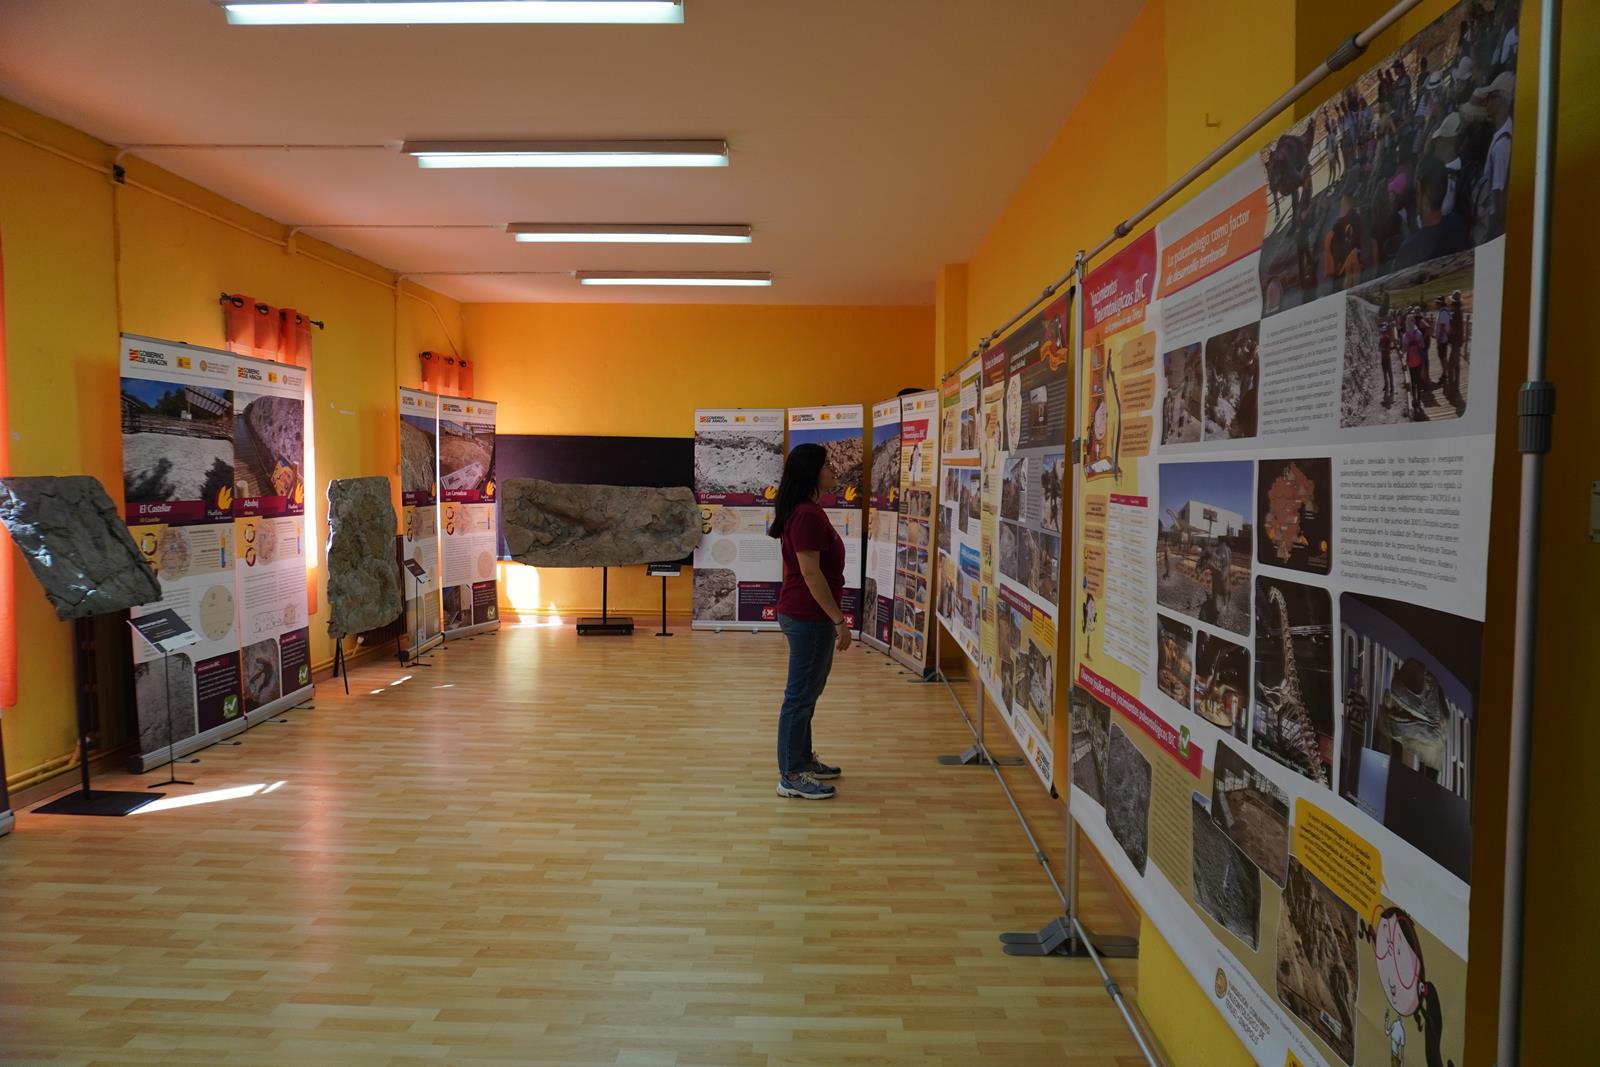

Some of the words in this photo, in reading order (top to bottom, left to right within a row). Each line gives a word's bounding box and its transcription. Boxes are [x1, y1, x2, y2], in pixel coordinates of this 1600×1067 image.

[1211, 224, 1228, 242] como
[1228, 210, 1250, 238] factor
[1134, 273, 1149, 304] BIC
[139, 504, 146, 513] El
